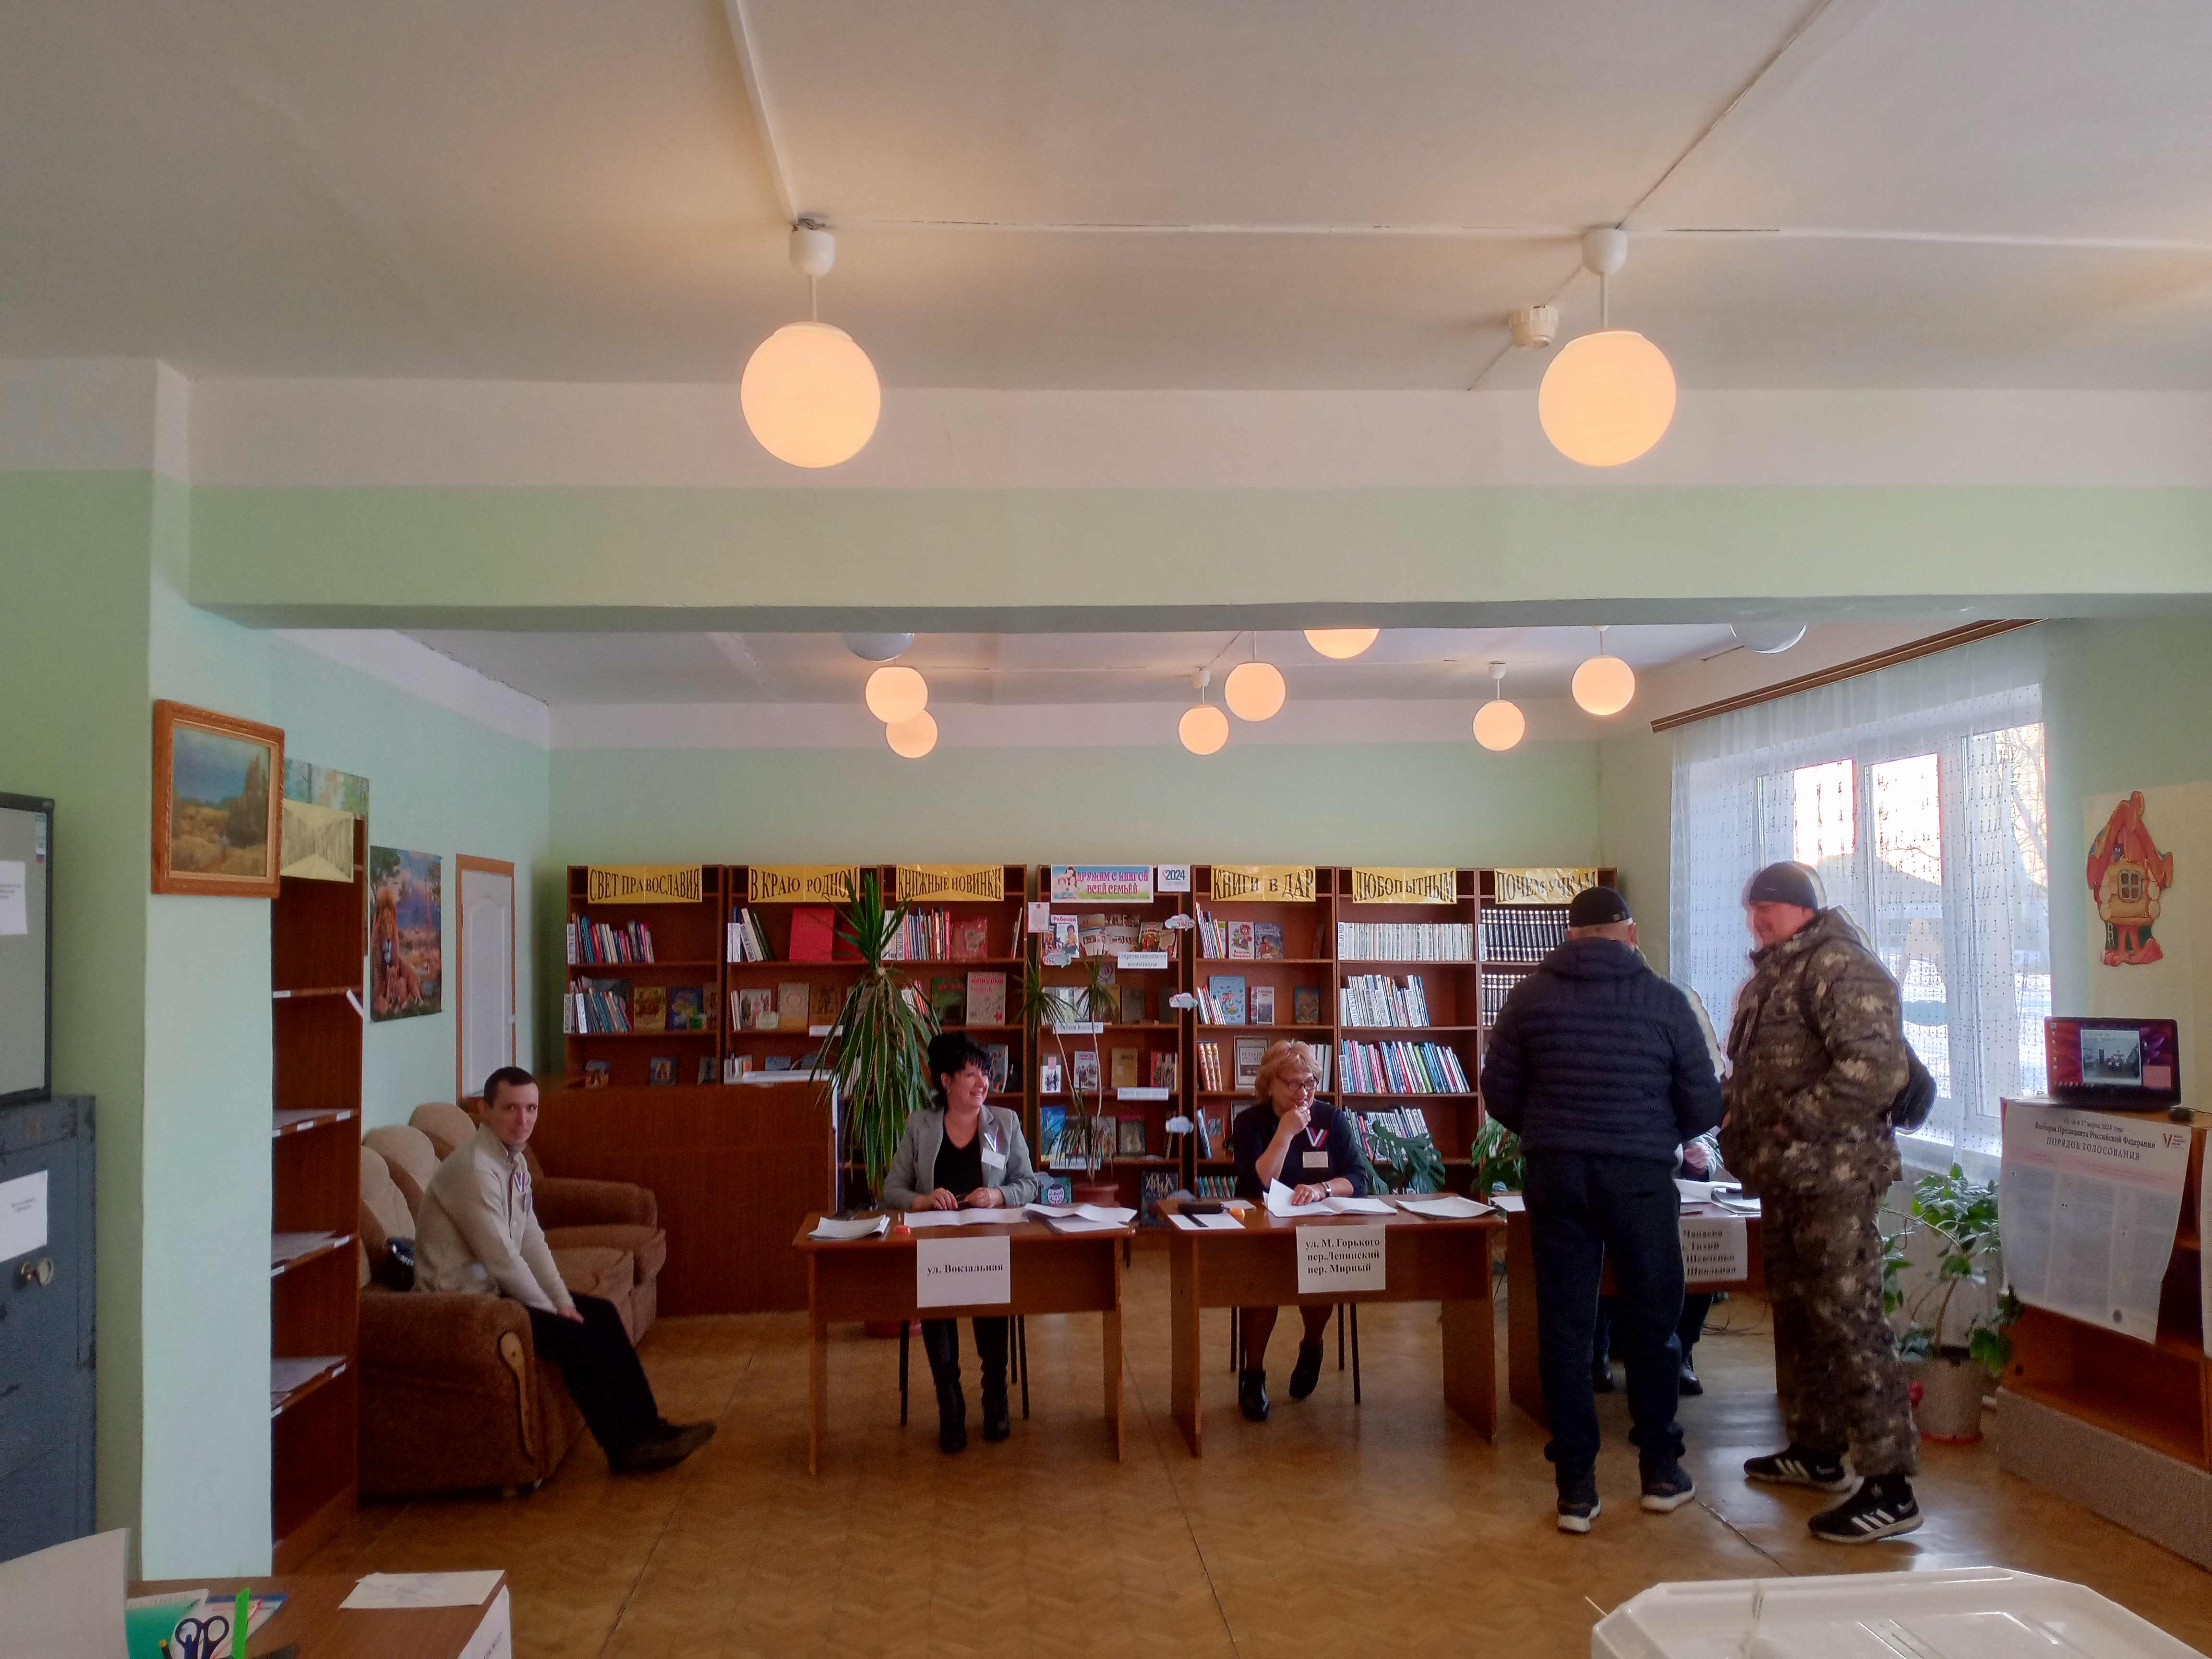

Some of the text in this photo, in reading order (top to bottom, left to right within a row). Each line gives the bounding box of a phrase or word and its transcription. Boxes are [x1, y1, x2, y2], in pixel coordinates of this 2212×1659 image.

[589, 868, 700, 901] СВЕТ ПРАВОСЛАВИЯ
[750, 867, 858, 901] В КРАЮ РОДНОМ
[898, 867, 1002, 900] КНИЖНЫЕ НОВИНКИ
[1077, 869, 1149, 882] ДРУЖИМ С КНИГОЙ
[1166, 869, 1186, 880] 2024
[1213, 868, 1259, 900] КНИГИ
[1282, 868, 1314, 900] ДАР
[1354, 870, 1455, 903] ЛЮБОПЫТНЫМ
[1496, 870, 1597, 902] ПОЧЕМУЧКАМ
[1087, 883, 1138, 894] ВСЕЙ СЕМЬЁЙ
[2035, 1121, 2155, 1149] Выборы Президента Российской Федерации
[2046, 1137, 2140, 1161] ПОРЯДОК ГОЛОСОВАНИЯ
[1305, 1238, 1380, 1250] ул. М. Горького
[1307, 1250, 1380, 1262] пер.Ленинский
[927, 1264, 1003, 1276] ул. Вокзальная
[1307, 1263, 1371, 1275] пер. Мирный
